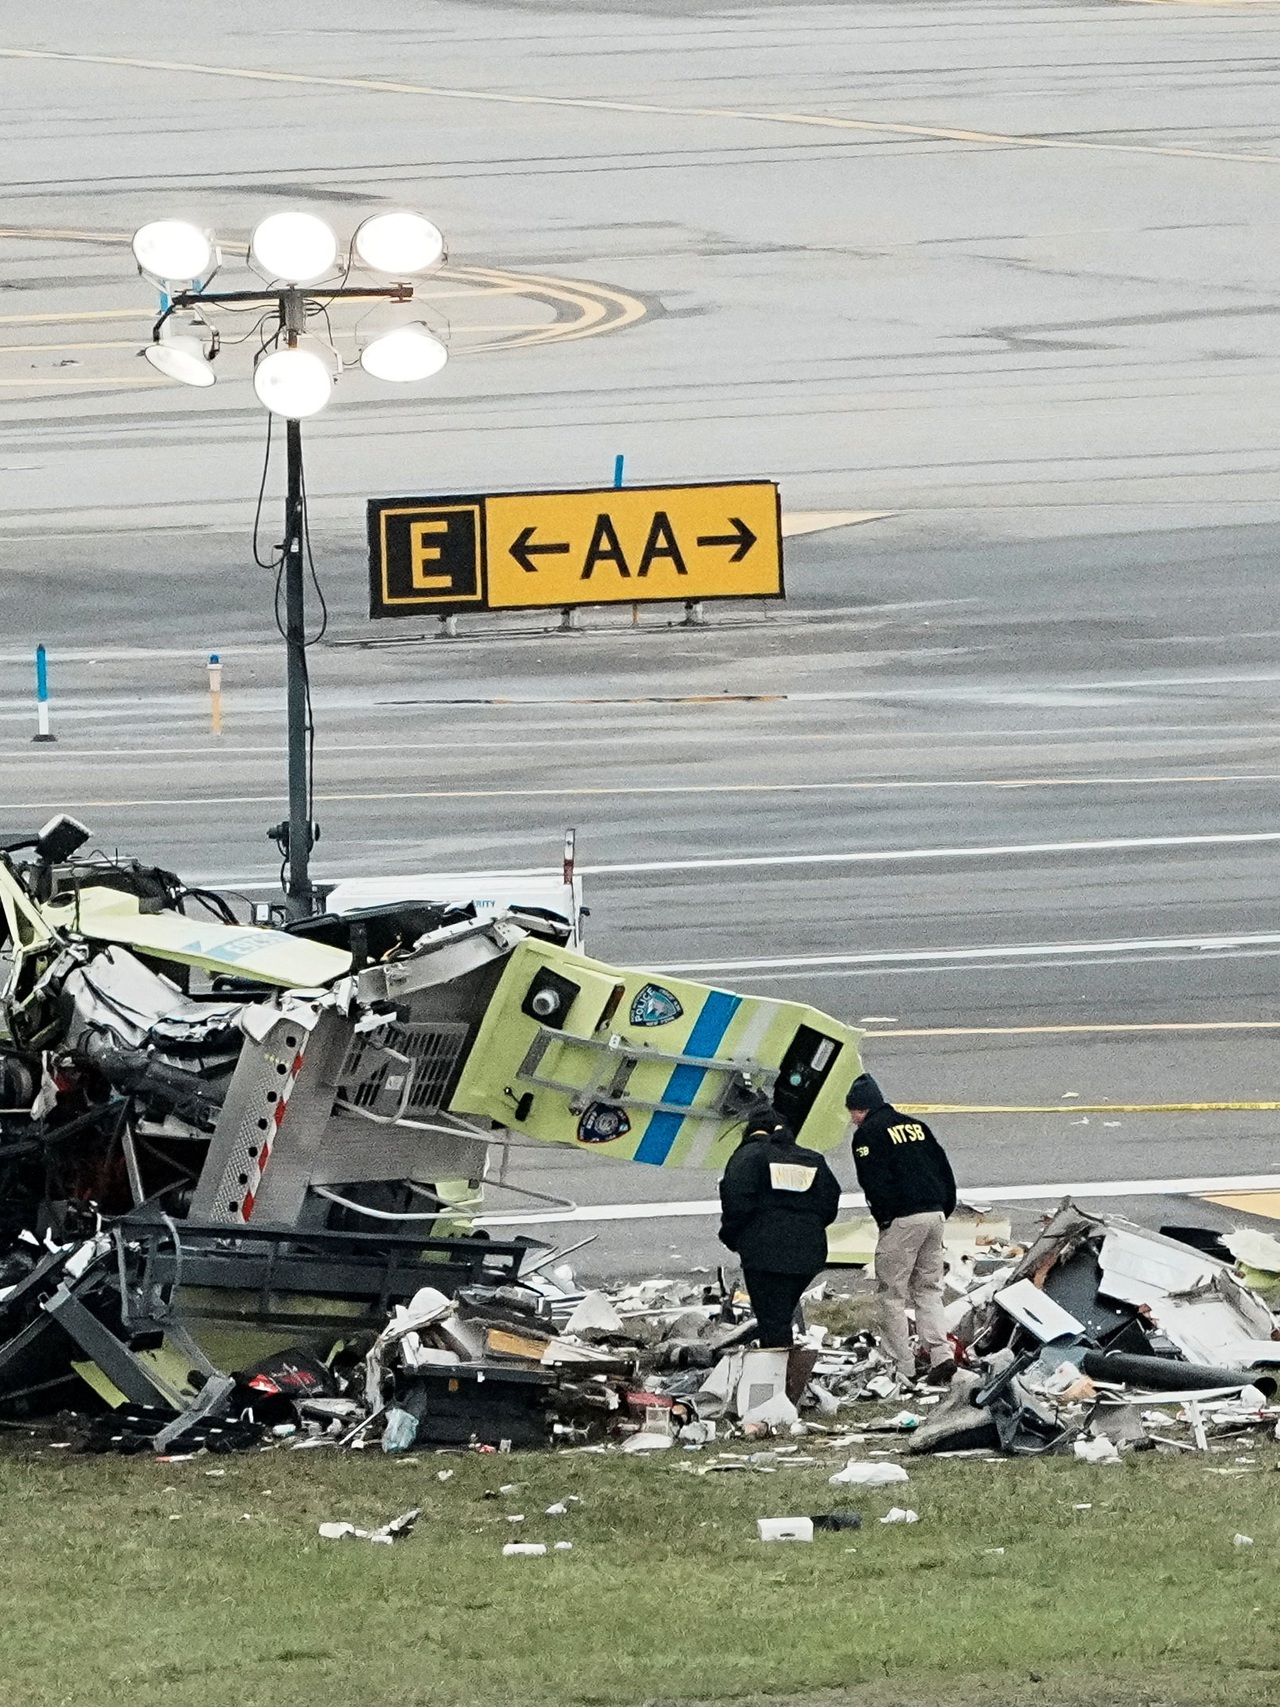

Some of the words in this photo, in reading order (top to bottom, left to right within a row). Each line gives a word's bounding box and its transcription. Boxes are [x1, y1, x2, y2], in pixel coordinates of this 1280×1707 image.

[410, 521, 452, 588] E
[580, 511, 688, 579] AA
[635, 987, 655, 1022] POLICE
[887, 1123, 926, 1144] NTSB
